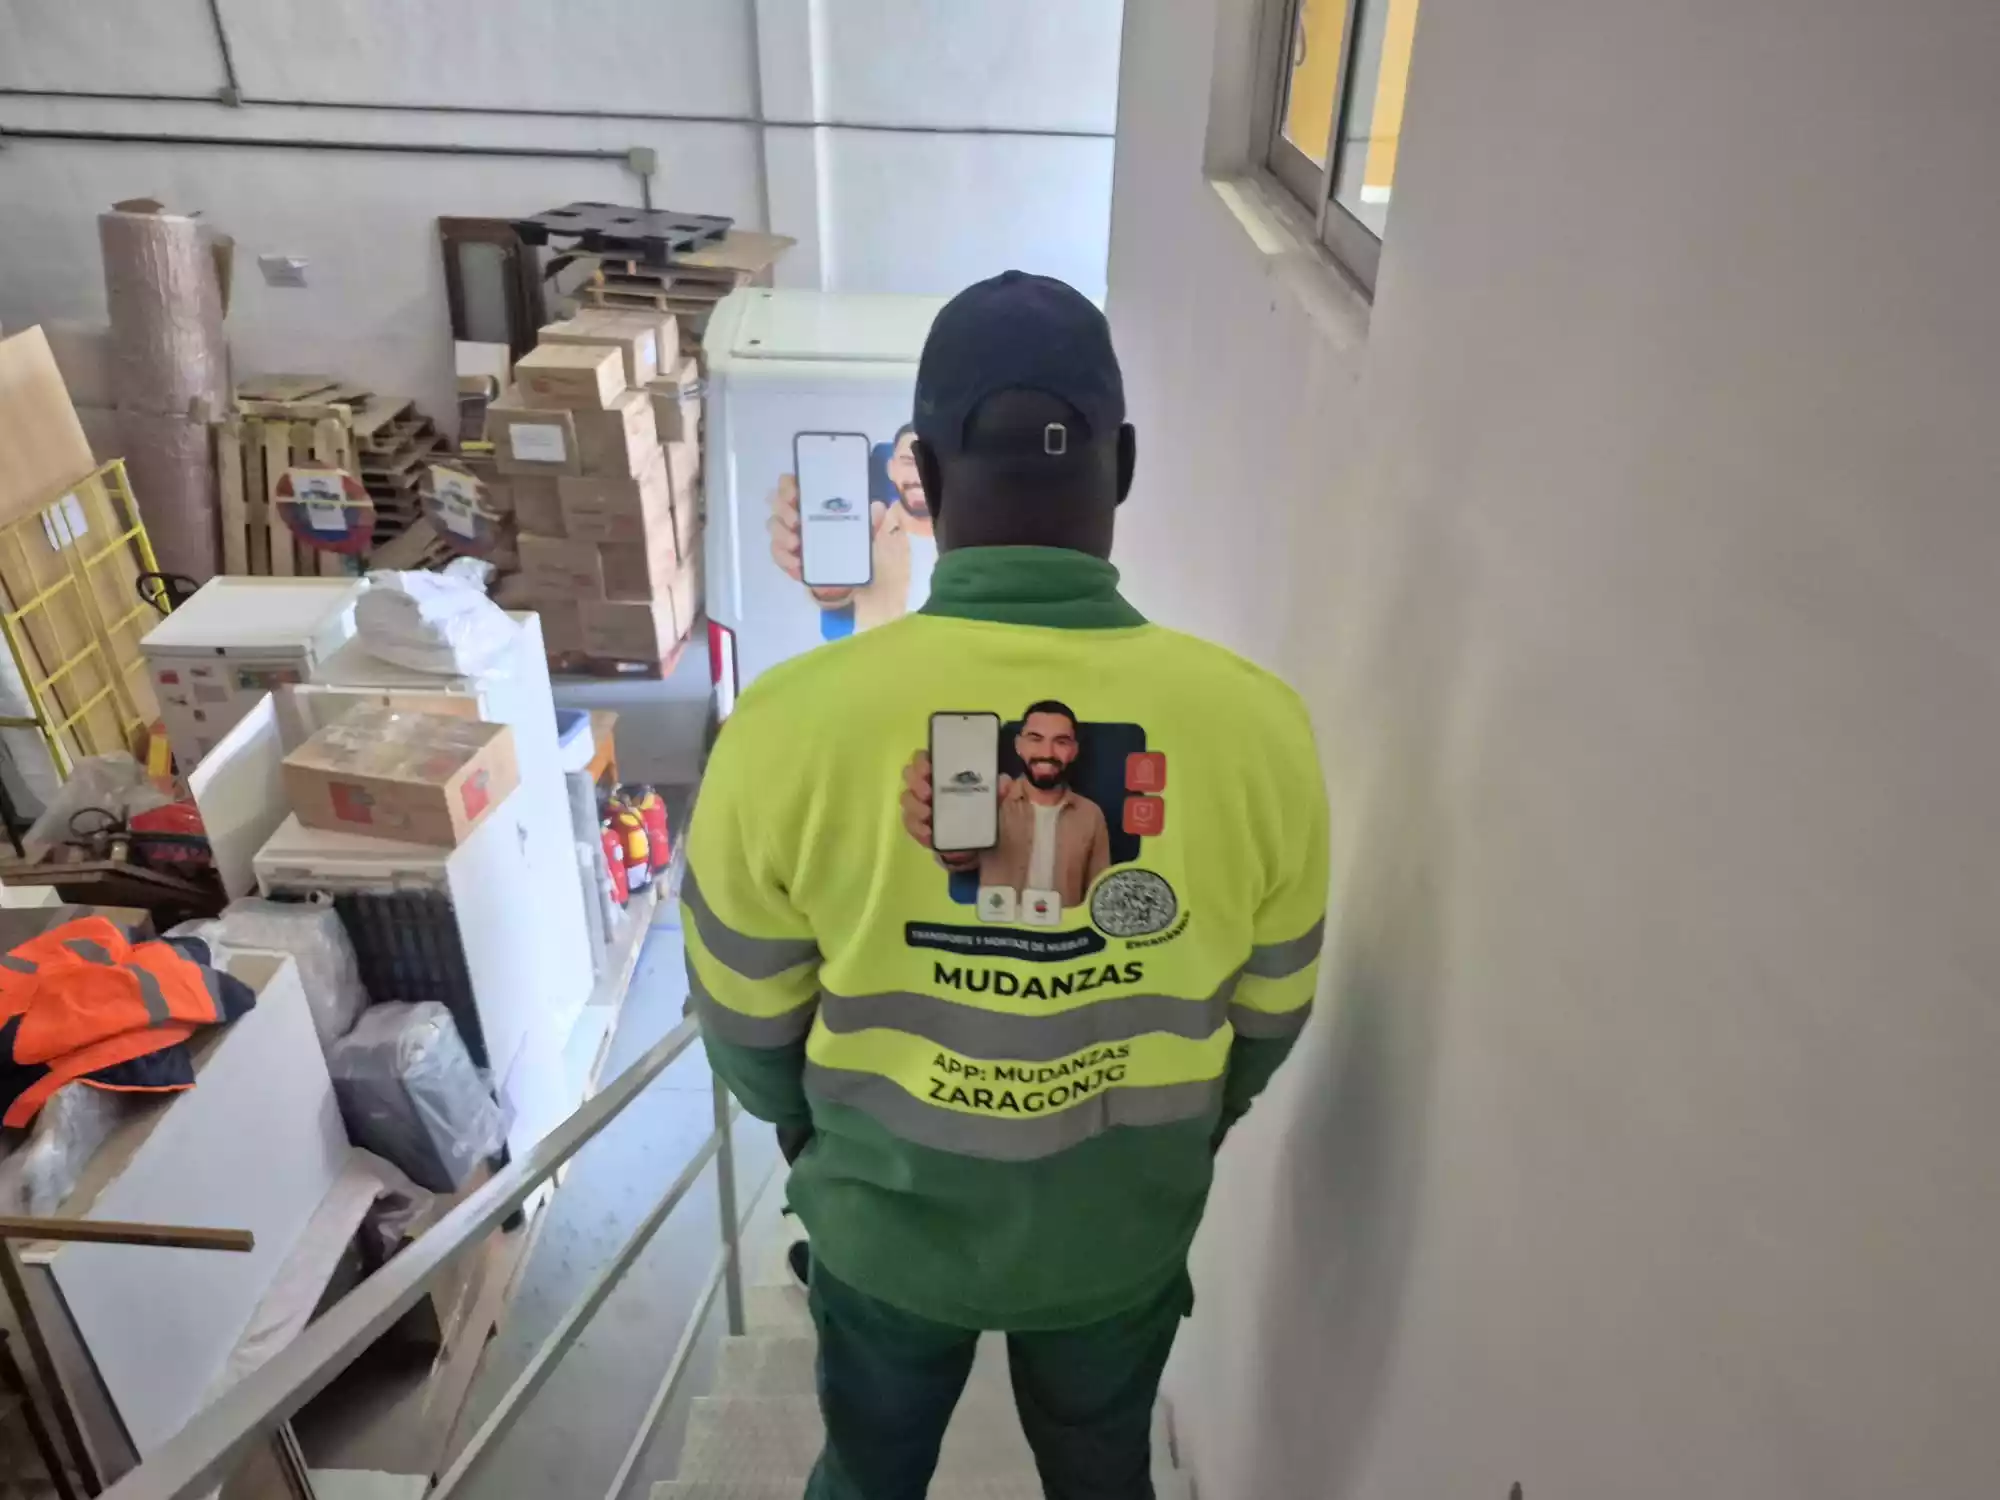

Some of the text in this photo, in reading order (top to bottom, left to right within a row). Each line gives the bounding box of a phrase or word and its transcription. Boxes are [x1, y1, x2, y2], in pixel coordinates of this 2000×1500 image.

[933, 961, 1144, 1000] MUDANZAS
[933, 1045, 1130, 1084] APP: MUDANZAS
[928, 1064, 1127, 1113] ZARAGONJG
